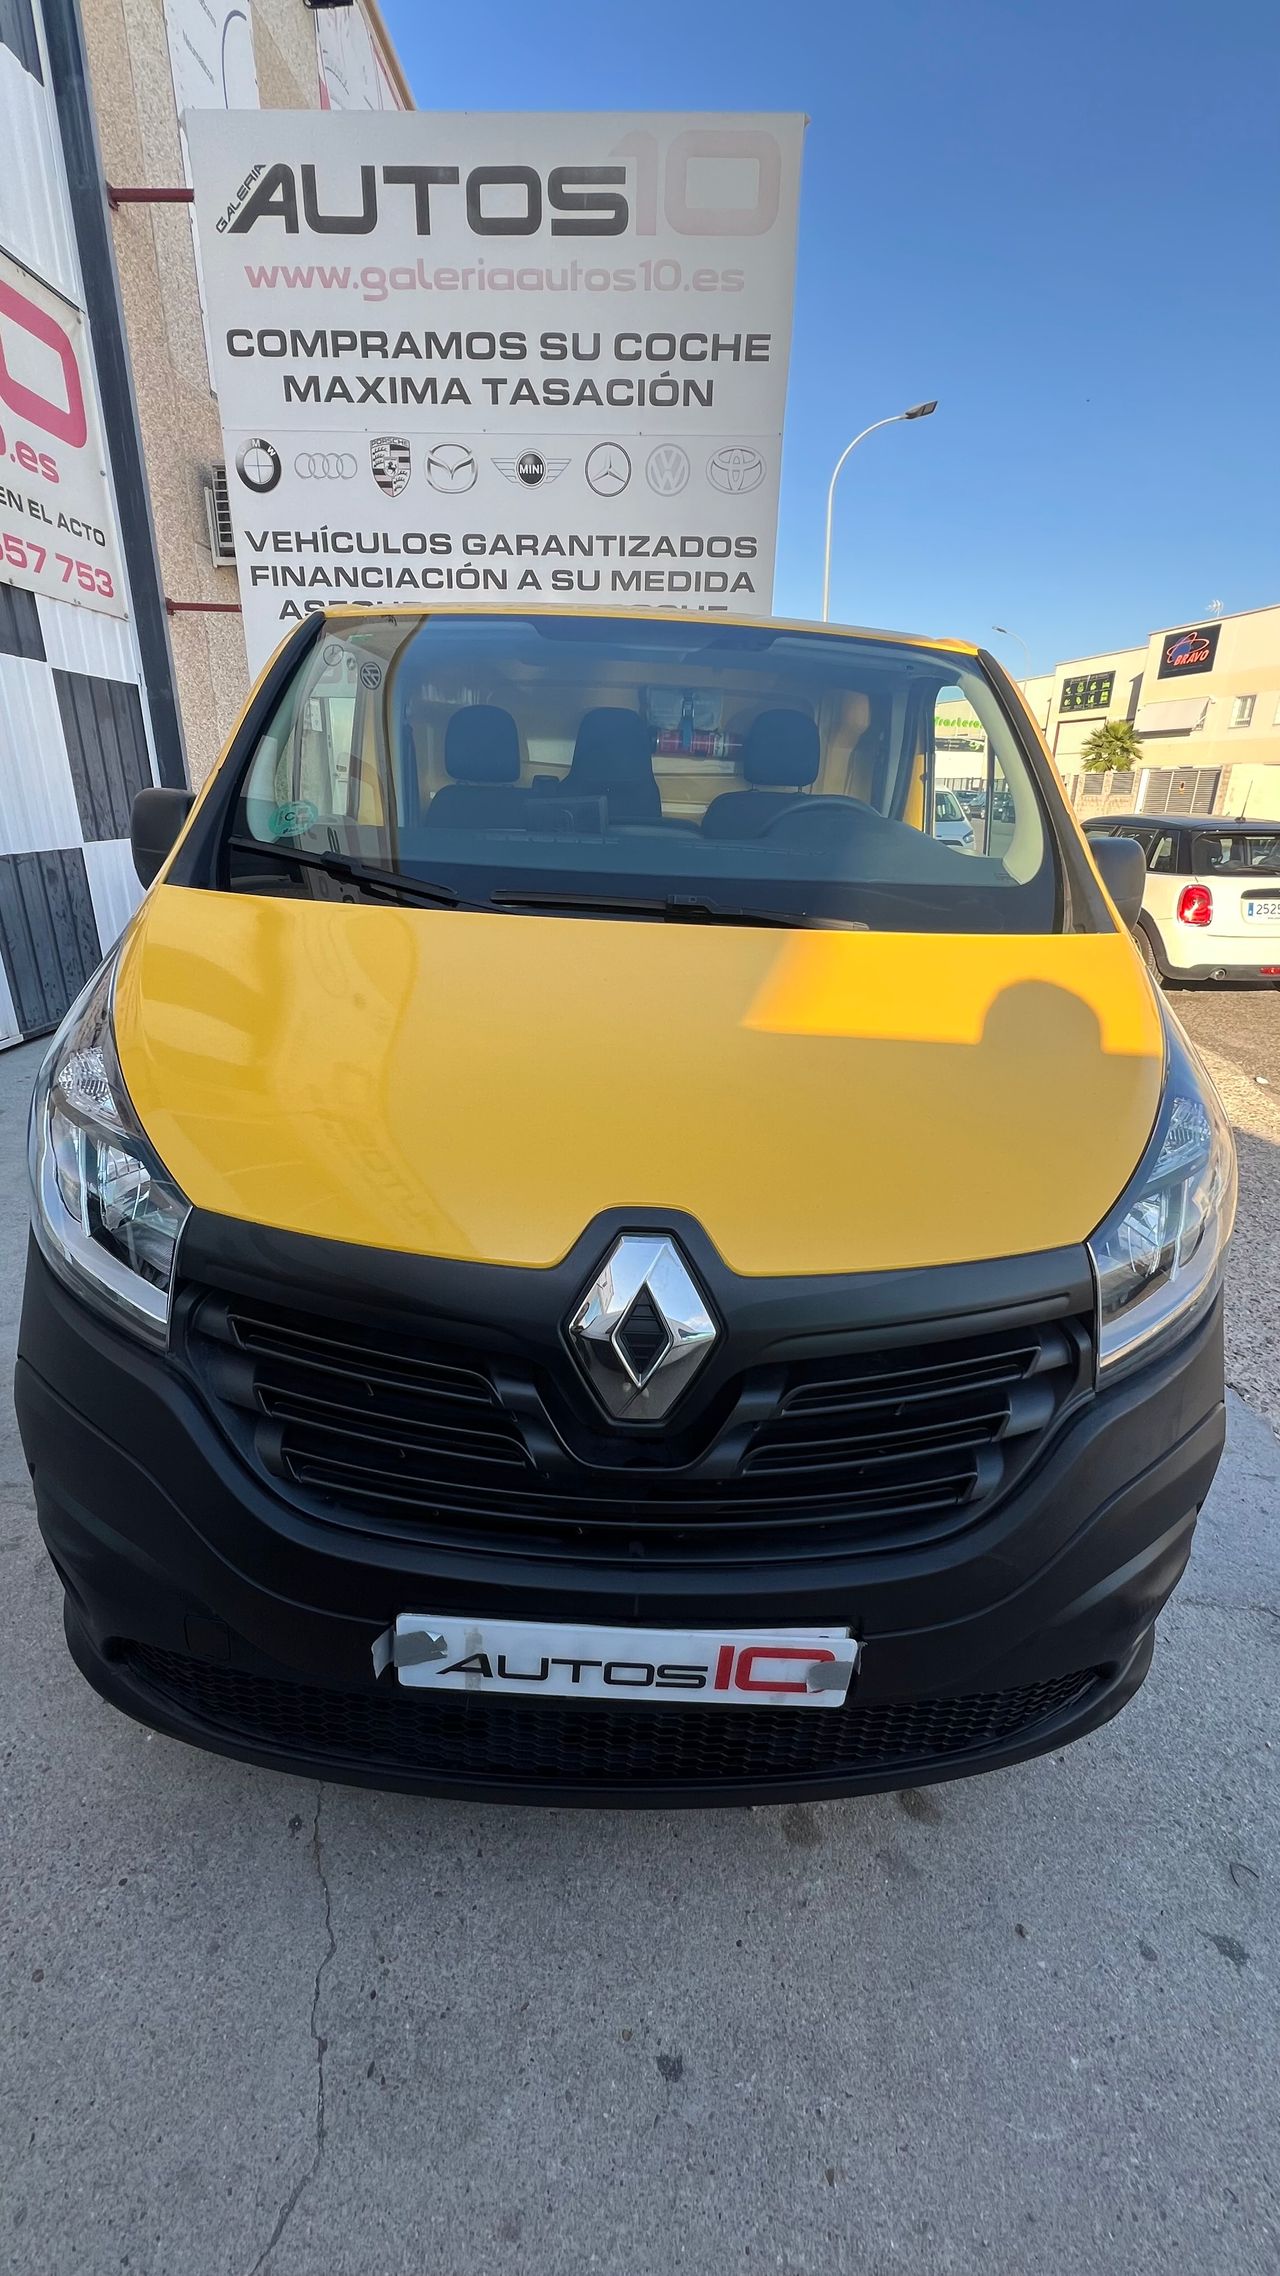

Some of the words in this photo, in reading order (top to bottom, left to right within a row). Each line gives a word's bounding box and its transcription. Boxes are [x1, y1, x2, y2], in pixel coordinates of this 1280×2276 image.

[215, 163, 266, 234] GALERIA
[244, 258, 745, 301] www.galeriaautos10.es
[226, 329, 528, 361] COMPRAMOS
[539, 332, 601, 362] SU
[614, 332, 772, 362] COCHE
[282, 375, 472, 405] MAXIMA
[481, 369, 714, 407] TASACIÓN
[518, 464, 544, 475] MINI
[27, 498, 53, 526] EL
[57, 511, 106, 547] ACTO
[244, 524, 453, 556] VEHÍCULOS
[461, 533, 758, 559] GARANTIZADOS
[0, 532, 47, 574] 57
[55, 552, 114, 599] 753
[250, 562, 508, 590] FINANCIACIÓN
[517, 568, 543, 591] A
[551, 569, 601, 591] SU
[610, 570, 756, 593] MEDIDA
[1173, 649, 1210, 666] BRAVO
